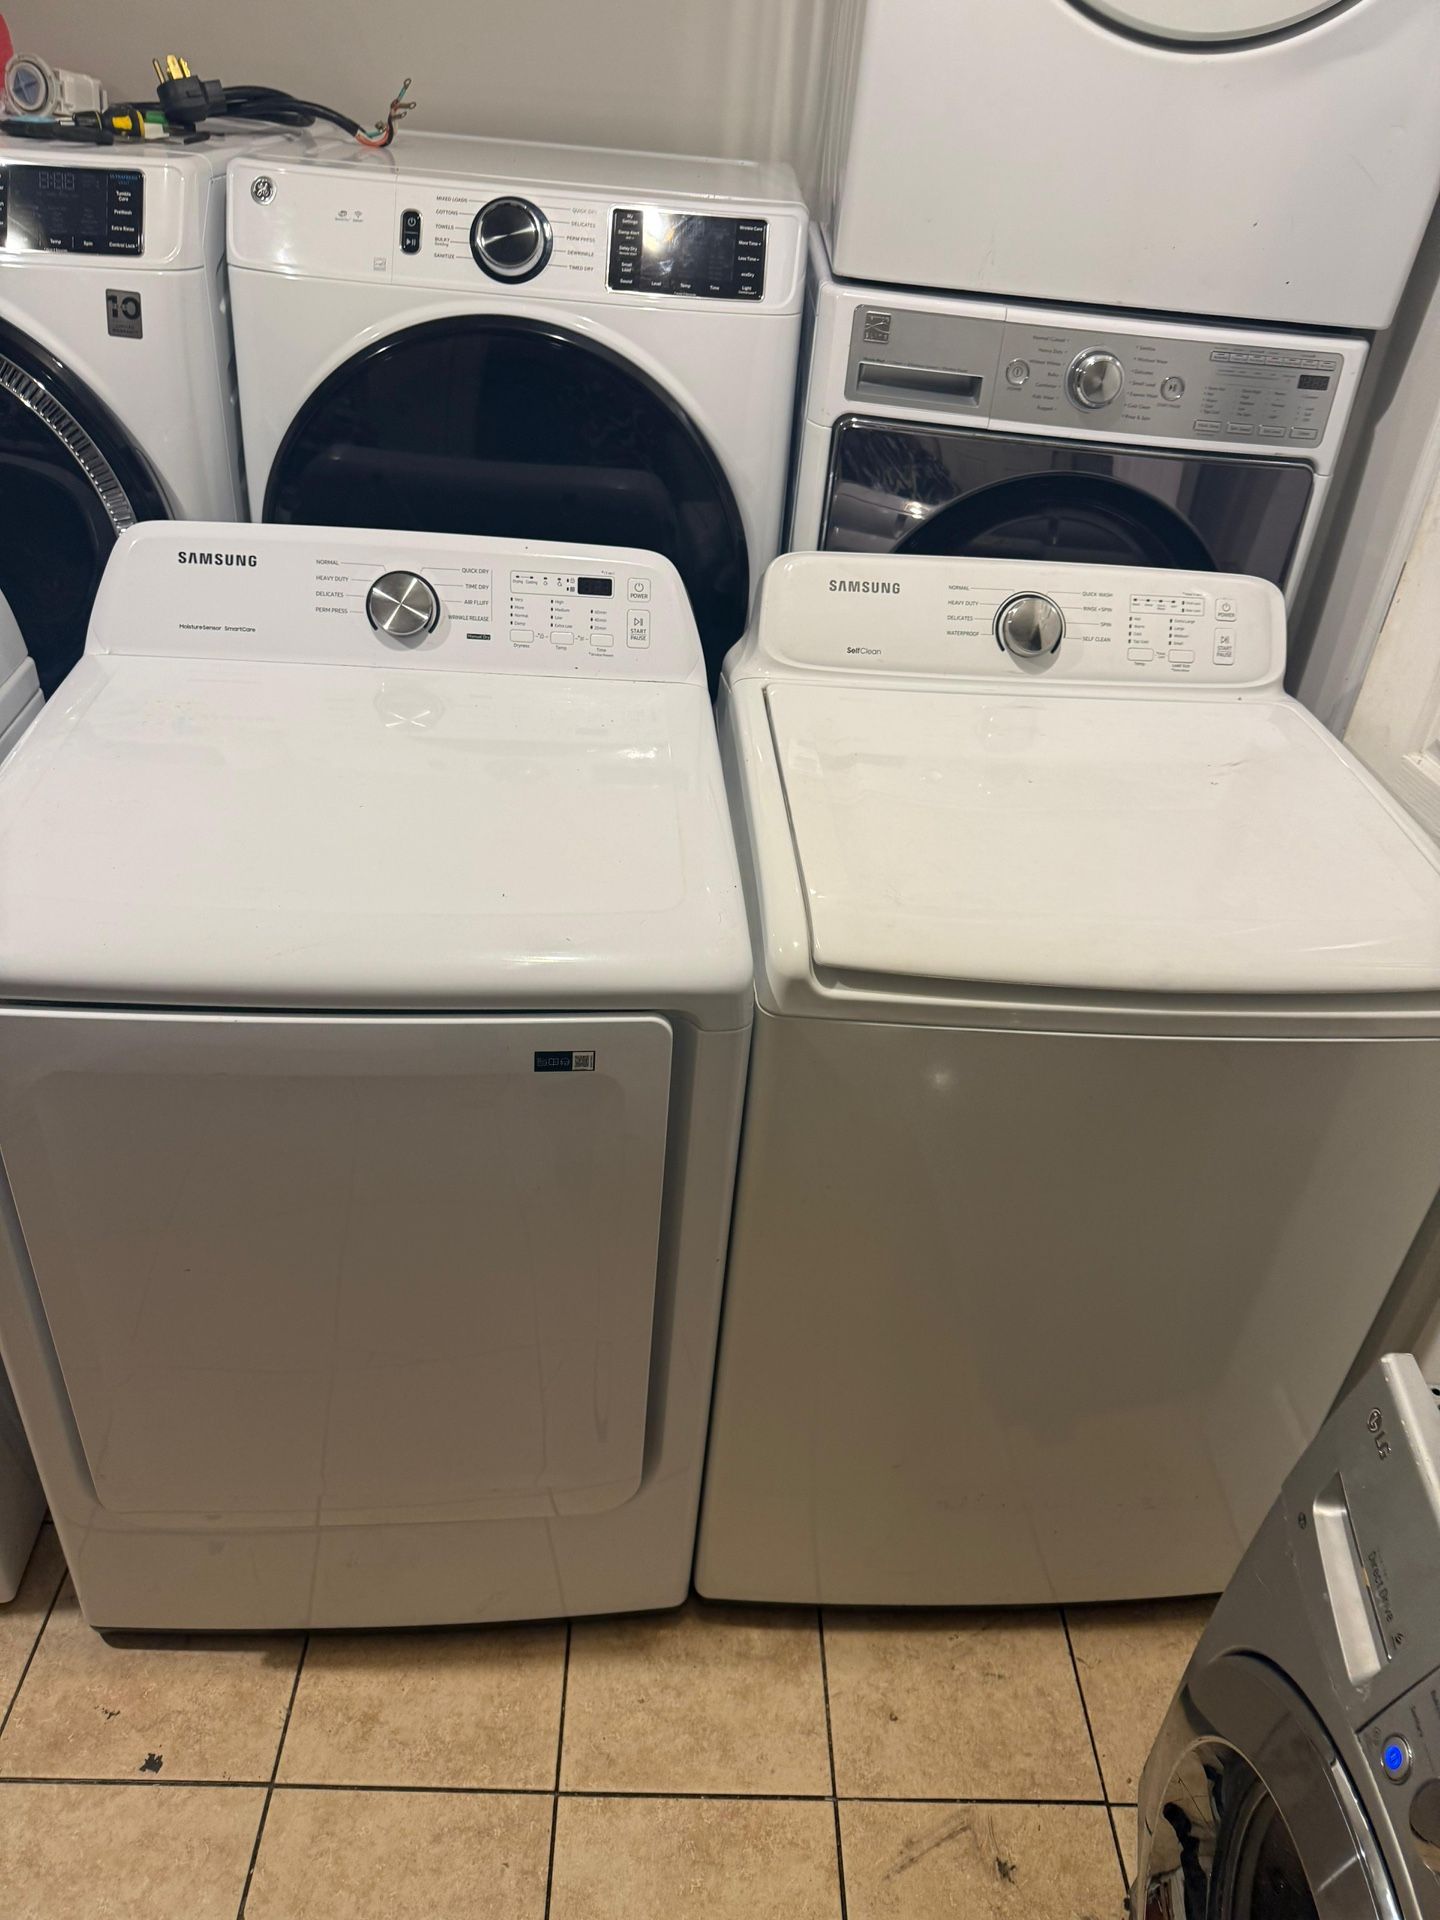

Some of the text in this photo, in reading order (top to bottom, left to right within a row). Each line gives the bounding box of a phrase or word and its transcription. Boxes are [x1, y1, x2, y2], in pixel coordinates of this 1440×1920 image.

[178, 552, 257, 567] SAMSUNG
[829, 580, 900, 594] SAMSUNG
[1374, 1431, 1391, 1460] LG
